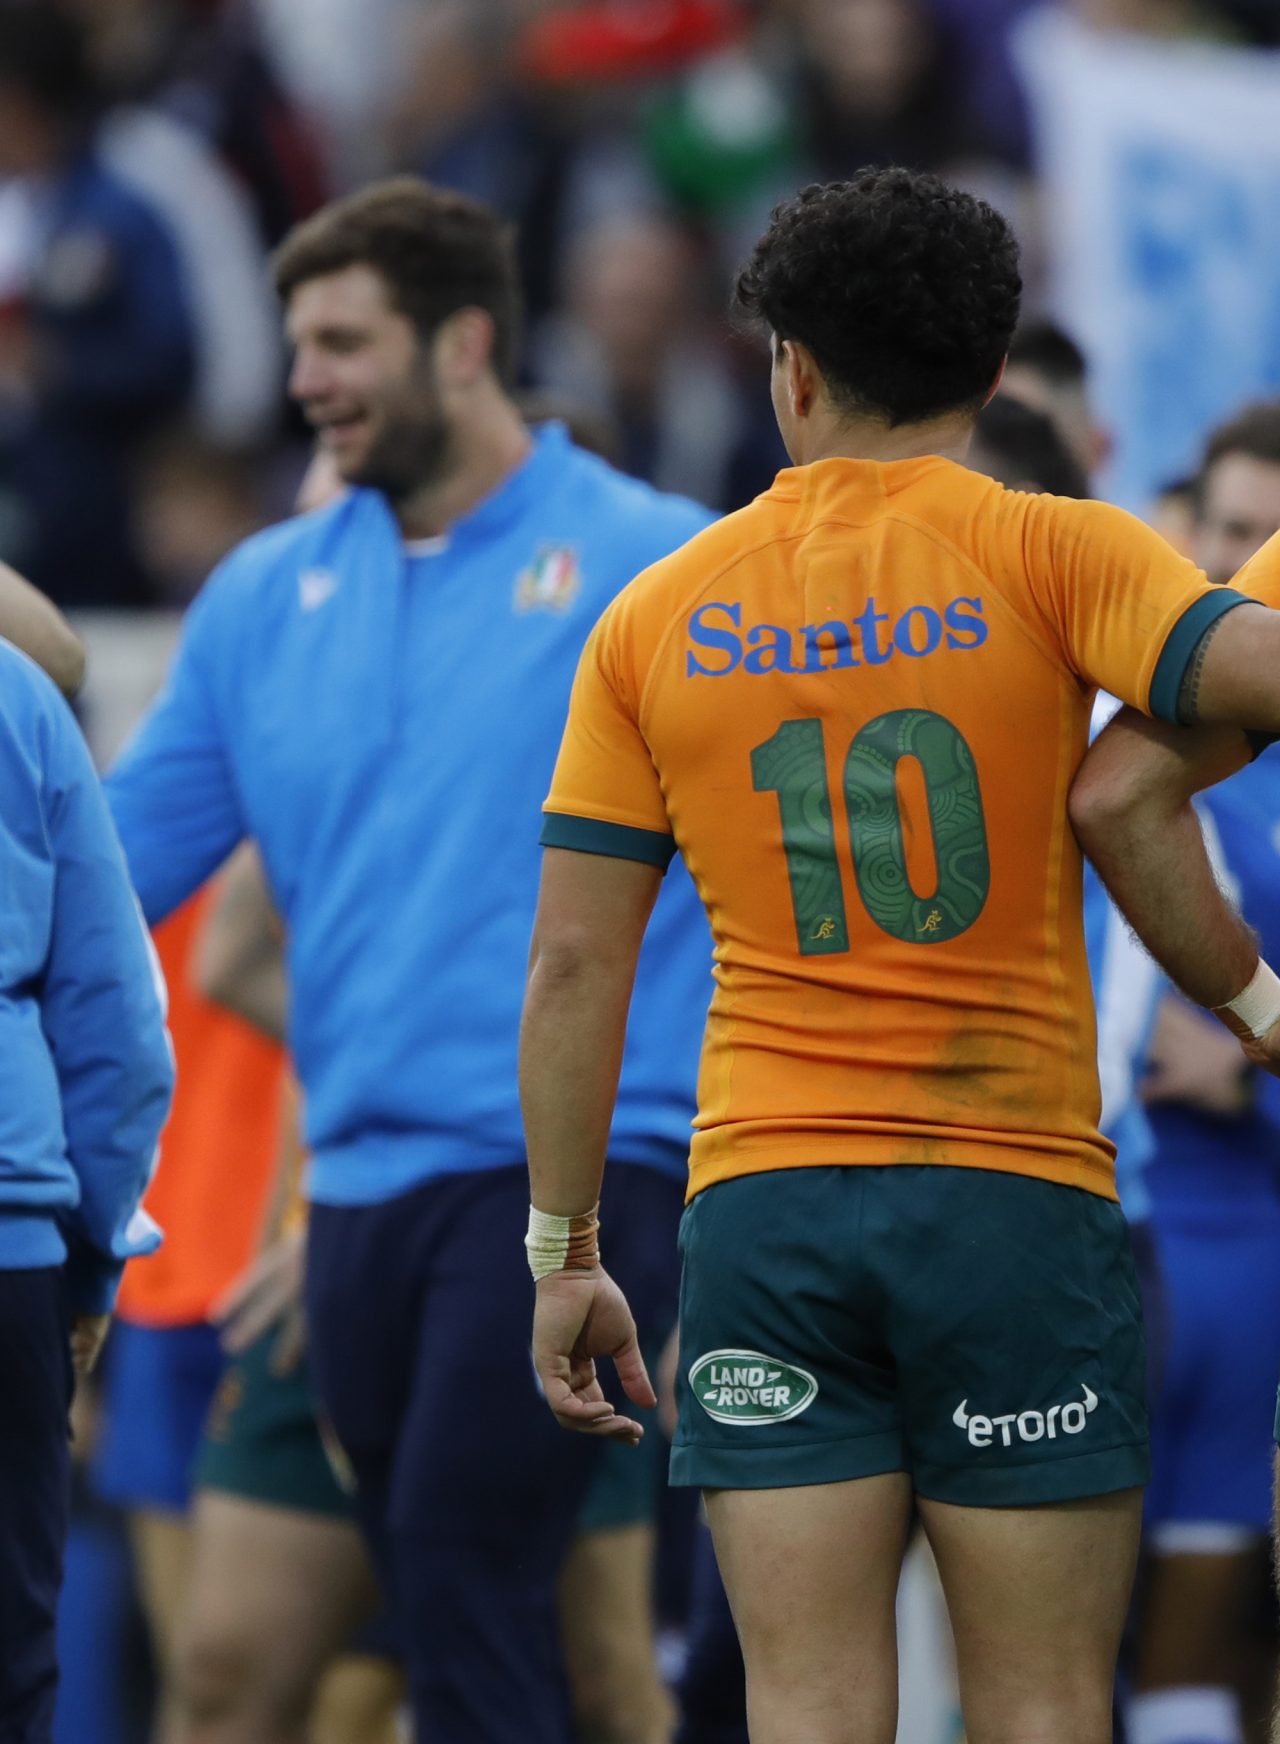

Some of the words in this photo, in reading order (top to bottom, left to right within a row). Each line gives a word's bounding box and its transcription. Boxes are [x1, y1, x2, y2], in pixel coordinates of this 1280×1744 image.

[685, 596, 988, 678] Santos
[750, 708, 990, 956] 10
[710, 1365, 767, 1388] LAND
[717, 1386, 790, 1407] ROVER
